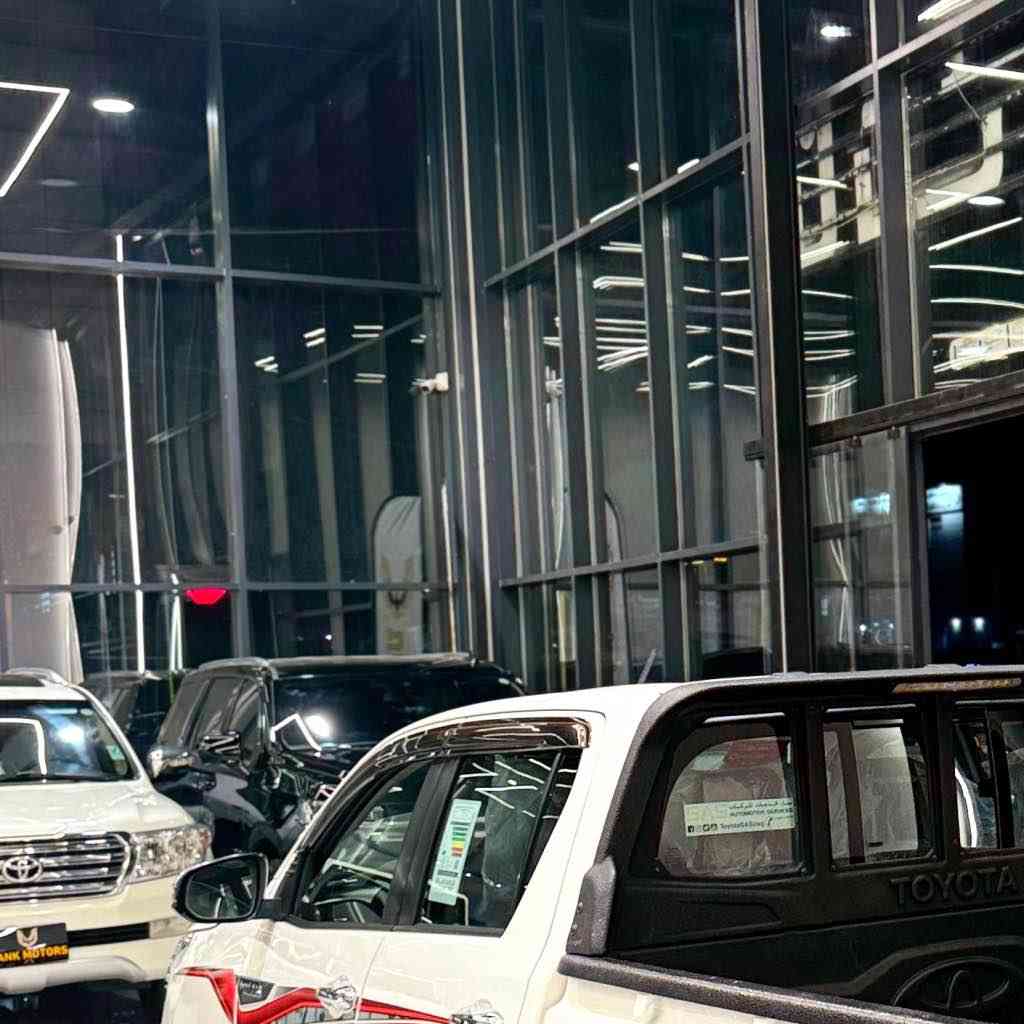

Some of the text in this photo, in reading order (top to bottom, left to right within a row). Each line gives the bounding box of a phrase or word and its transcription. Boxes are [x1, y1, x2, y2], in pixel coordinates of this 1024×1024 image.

[889, 865, 1018, 904] TOYOTA
[0, 944, 69, 961] ANK MOTORS
